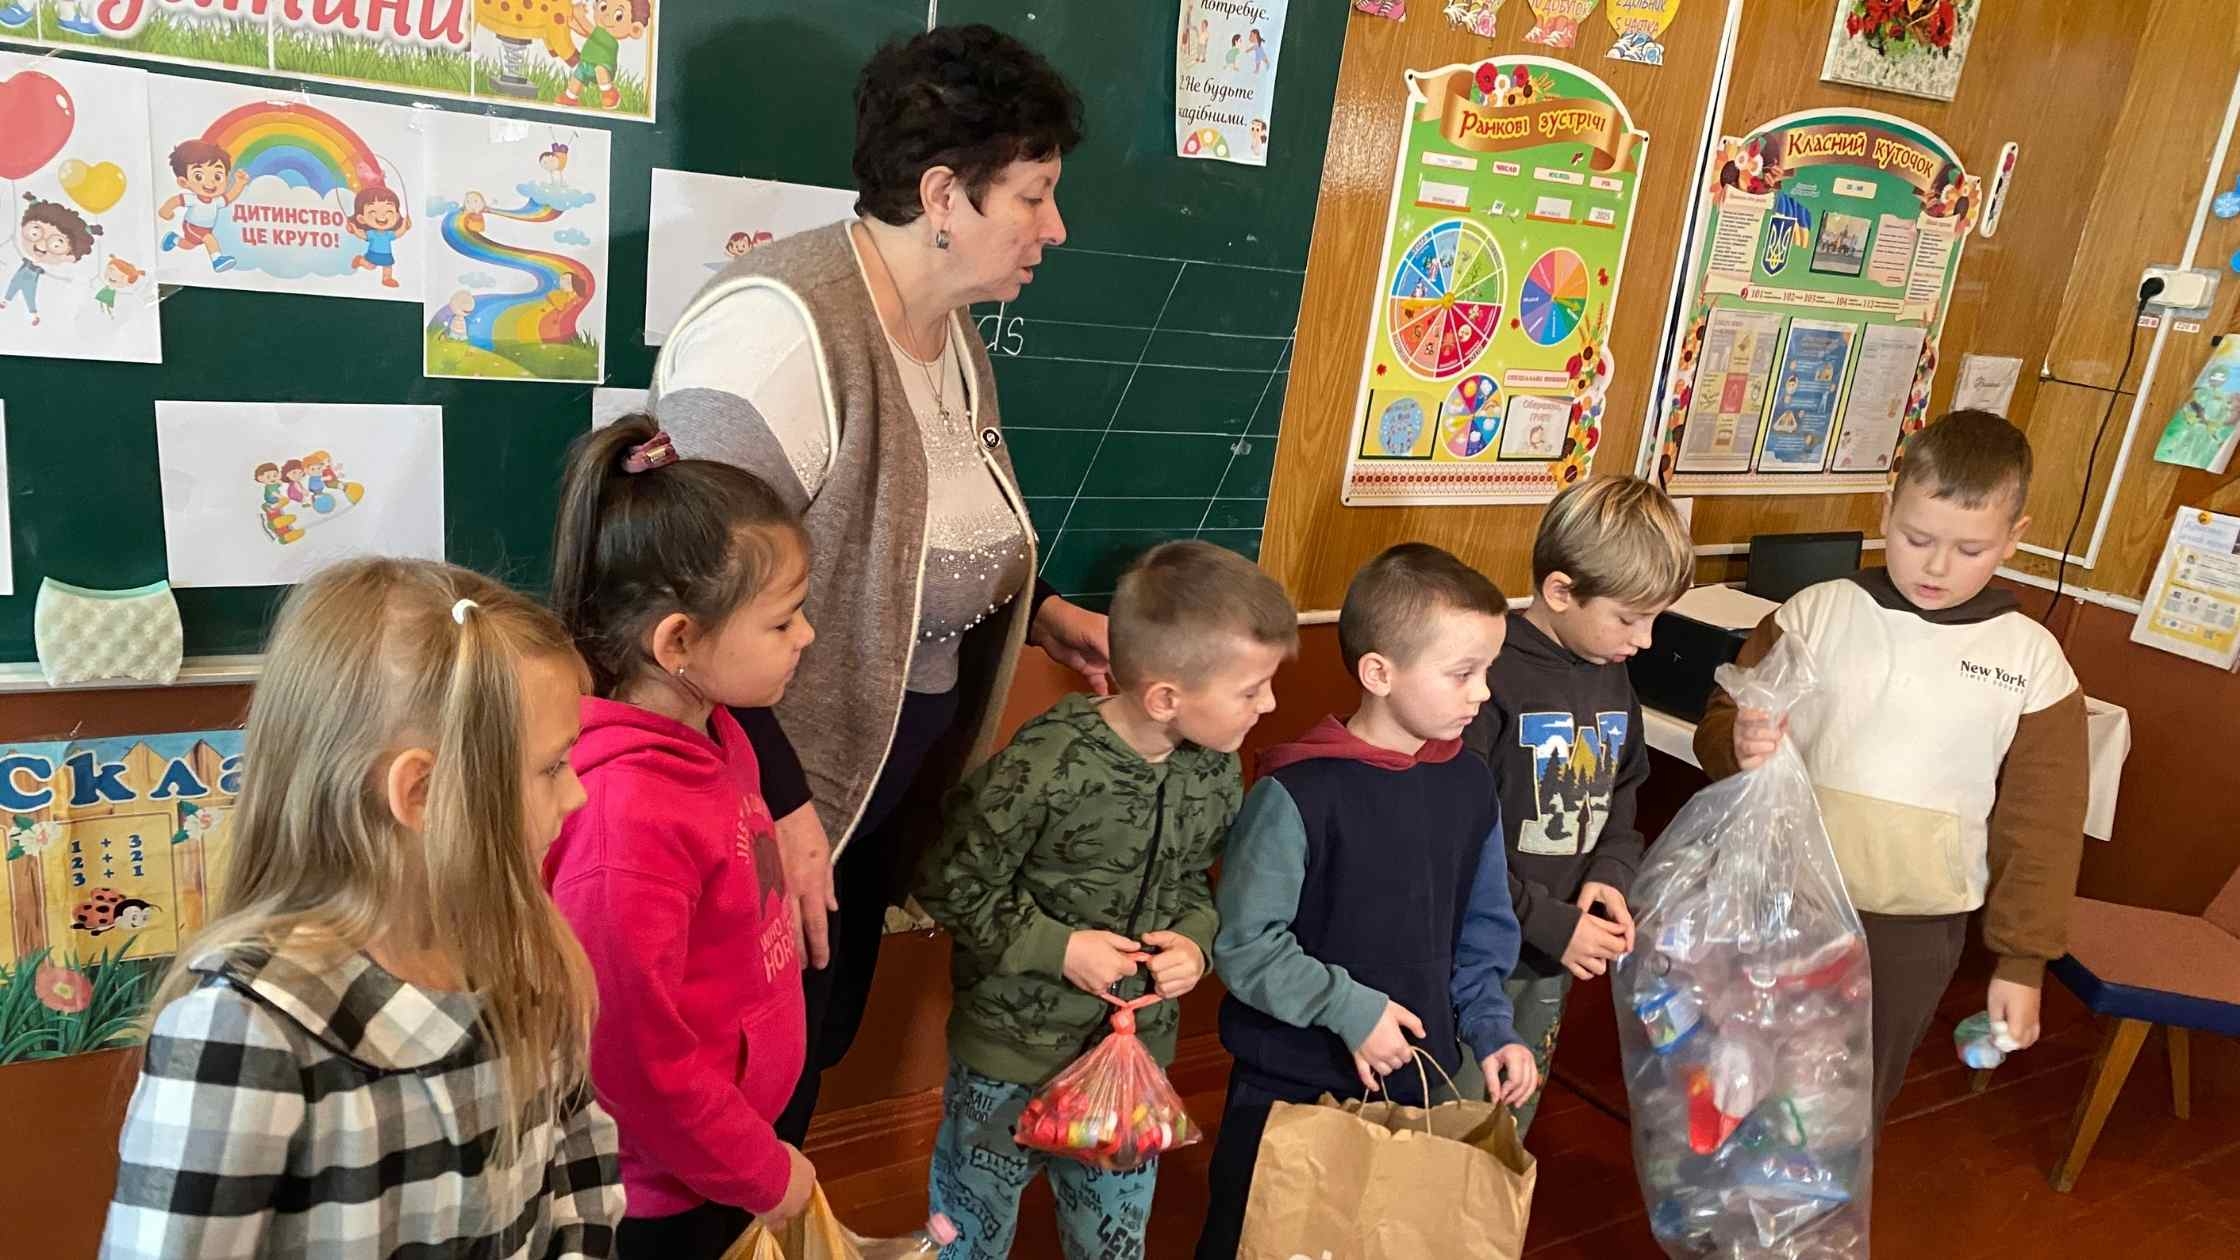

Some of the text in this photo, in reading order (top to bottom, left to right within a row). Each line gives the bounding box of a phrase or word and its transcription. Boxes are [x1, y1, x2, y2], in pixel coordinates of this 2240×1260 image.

[1203, 77, 1254, 102] будьте
[1459, 110, 1606, 138] Ранкові зустрічі
[1787, 132, 1935, 178] Класний куточок
[232, 204, 344, 226] ДИТИНСТВО
[242, 227, 340, 248] ЦЕ КРУТО!
[1960, 659, 1992, 676] New
[1995, 667, 2027, 687] York
[71, 841, 82, 854] 1
[129, 834, 142, 849] 3
[71, 856, 84, 870] 2
[130, 850, 144, 863] 2
[73, 872, 86, 888] 3
[132, 864, 145, 877] 1
